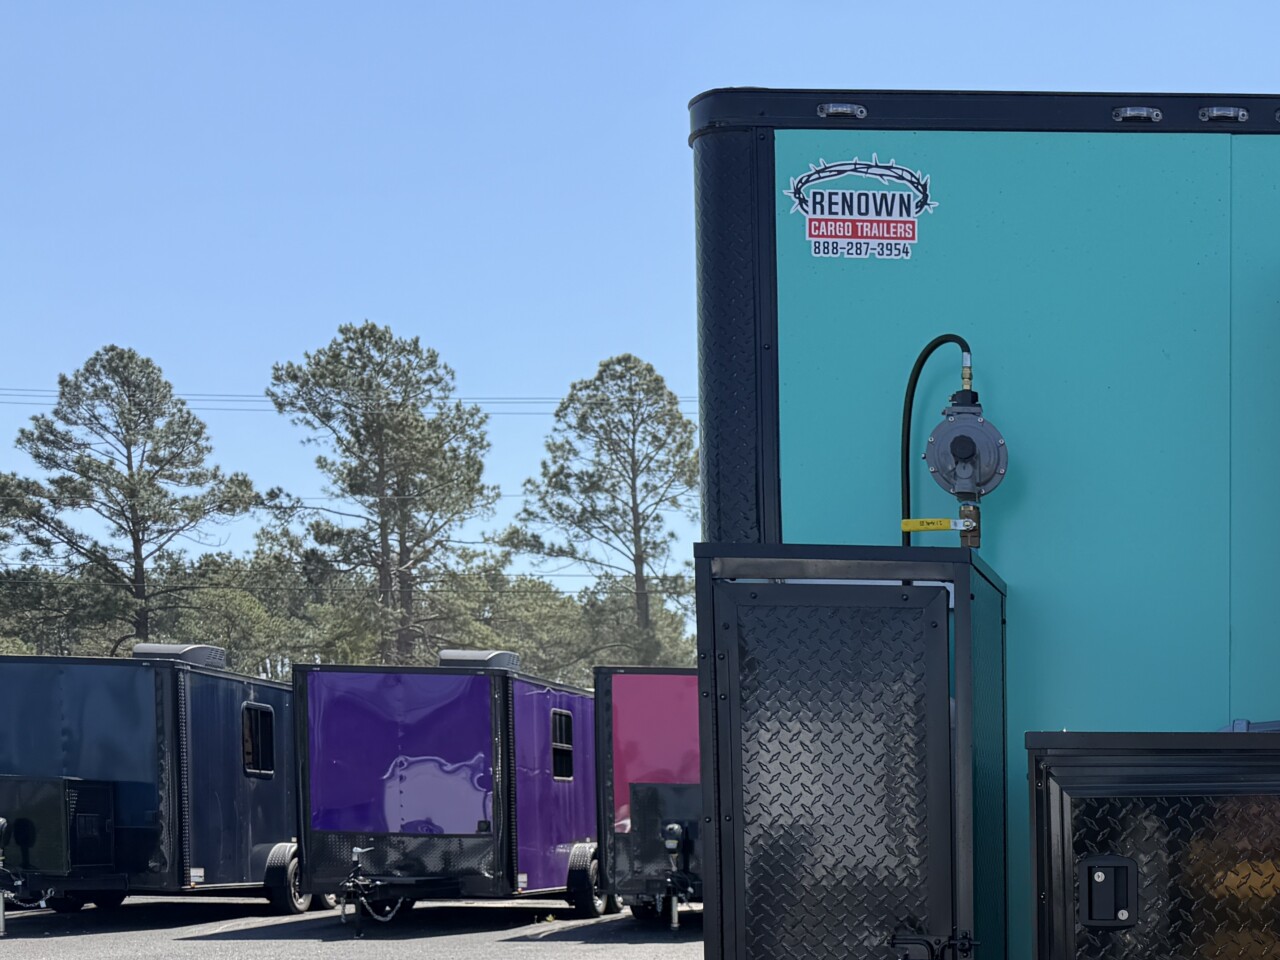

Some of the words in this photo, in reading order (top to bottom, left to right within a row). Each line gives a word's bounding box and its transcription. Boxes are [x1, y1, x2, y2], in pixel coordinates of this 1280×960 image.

[811, 191, 912, 218] RENOWN
[811, 221, 853, 237] CARGO
[856, 222, 913, 238] TRAILERS
[813, 240, 910, 257] 888-287-3954
